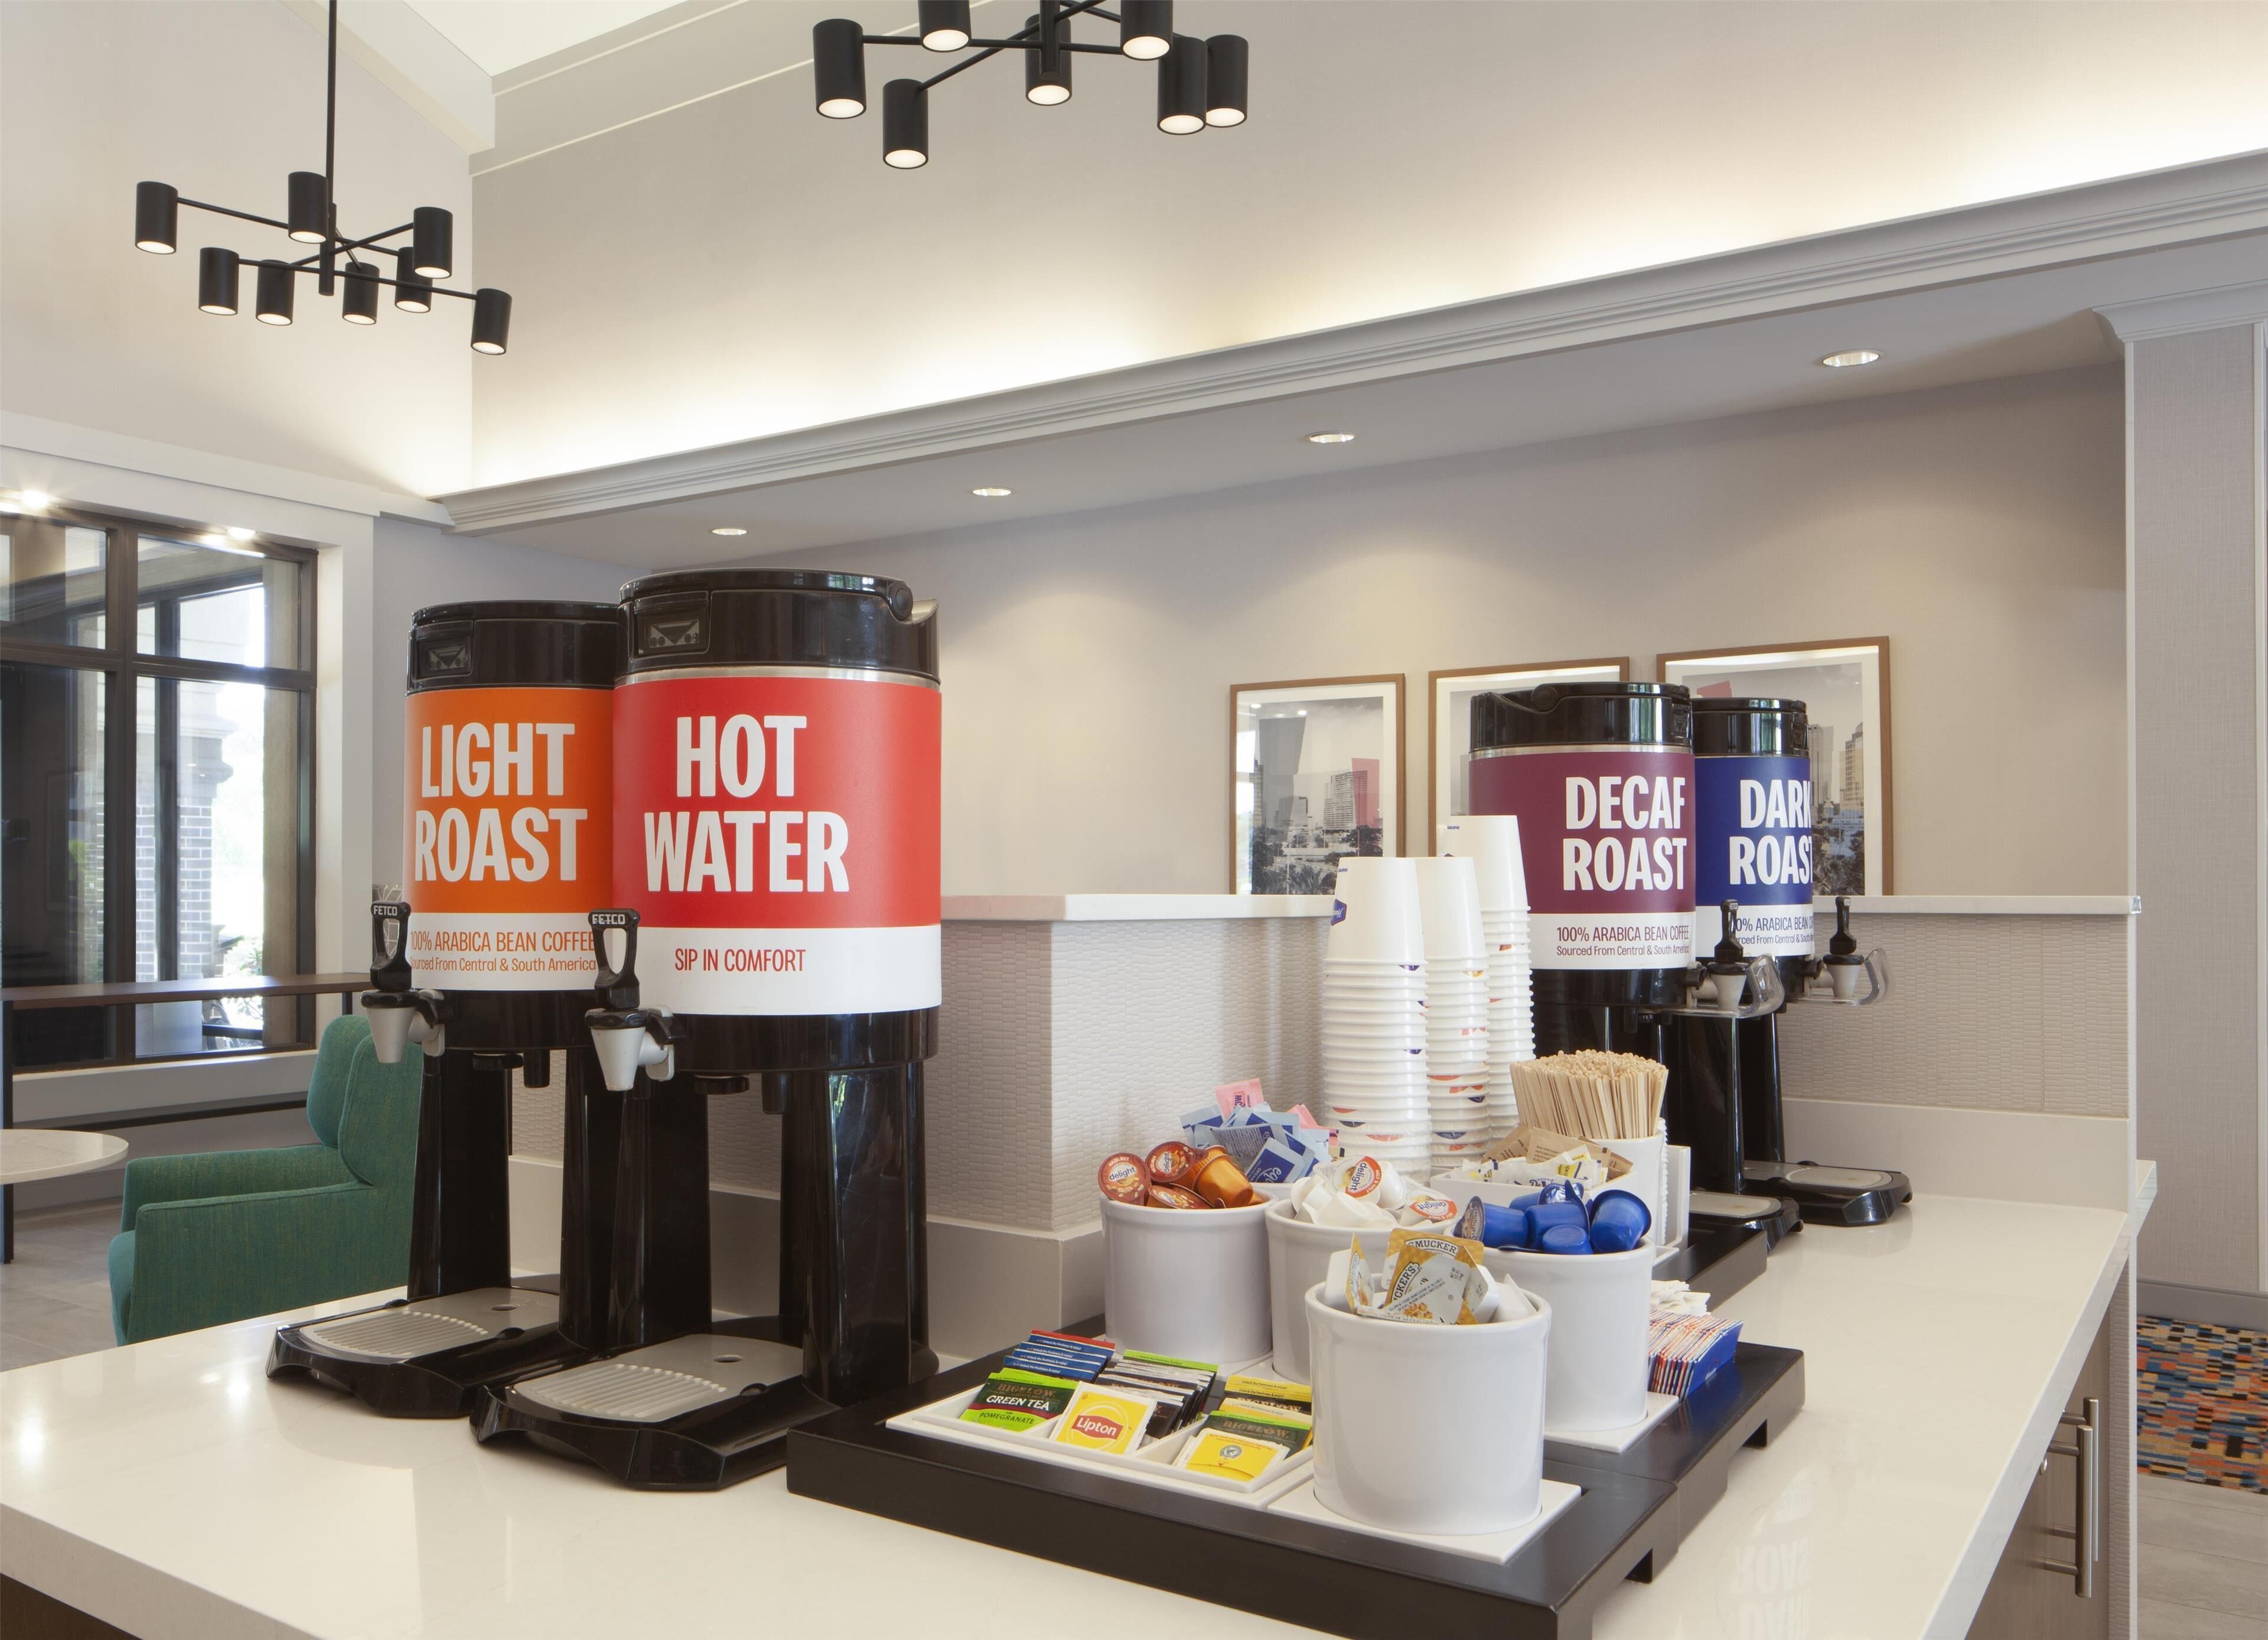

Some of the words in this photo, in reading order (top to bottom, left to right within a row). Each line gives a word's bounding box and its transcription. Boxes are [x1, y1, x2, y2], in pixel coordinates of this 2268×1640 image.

[422, 723, 575, 797] LIGHT
[677, 714, 807, 798] HOT
[1566, 775, 1685, 829] DECAF
[415, 807, 588, 882] ROAST
[644, 811, 849, 892] WATER
[1563, 837, 1687, 891] ROAST
[373, 906, 397, 916] FETCO
[592, 914, 625, 925] FETCO
[1736, 917, 1753, 931] 0%
[1755, 917, 1793, 931] ARABICA
[1794, 916, 1808, 930] BEAN
[410, 930, 432, 951] 100%
[435, 931, 491, 952] ARABICA
[496, 931, 536, 952] BEAN
[1556, 927, 1589, 942] 100%
[1593, 926, 1641, 942] ARABICA
[1644, 926, 1667, 941] BEAN
[1670, 925, 1689, 941] COFFEE
[1757, 935, 1773, 944] From
[1775, 934, 1795, 944] Central
[1795, 934, 1800, 943] &
[1556, 946, 1592, 956] Sourced
[1594, 946, 1615, 955] From
[1617, 945, 1644, 955] Central
[1647, 945, 1652, 955] &
[1654, 945, 1671, 954] South
[1673, 944, 1690, 954] America
[410, 956, 434, 970] Sourced
[436, 958, 457, 971] From
[459, 958, 496, 971] Central
[500, 958, 509, 971] &
[511, 958, 545, 971] South
[548, 957, 596, 971] America
[674, 948, 697, 971] SIP
[703, 949, 718, 971] IN
[724, 949, 806, 971] COMFORT
[1108, 1156, 1129, 1167] HAZELNUT
[1109, 1167, 1136, 1180] delight
[1350, 1163, 1367, 1190] delight
[1418, 1202, 1446, 1210] delight
[986, 1395, 1027, 1406] GREEN
[1027, 1399, 1050, 1411] TEA
[979, 1413, 1035, 1424] POMEGRANATE
[1077, 1417, 1117, 1436] Lipton
